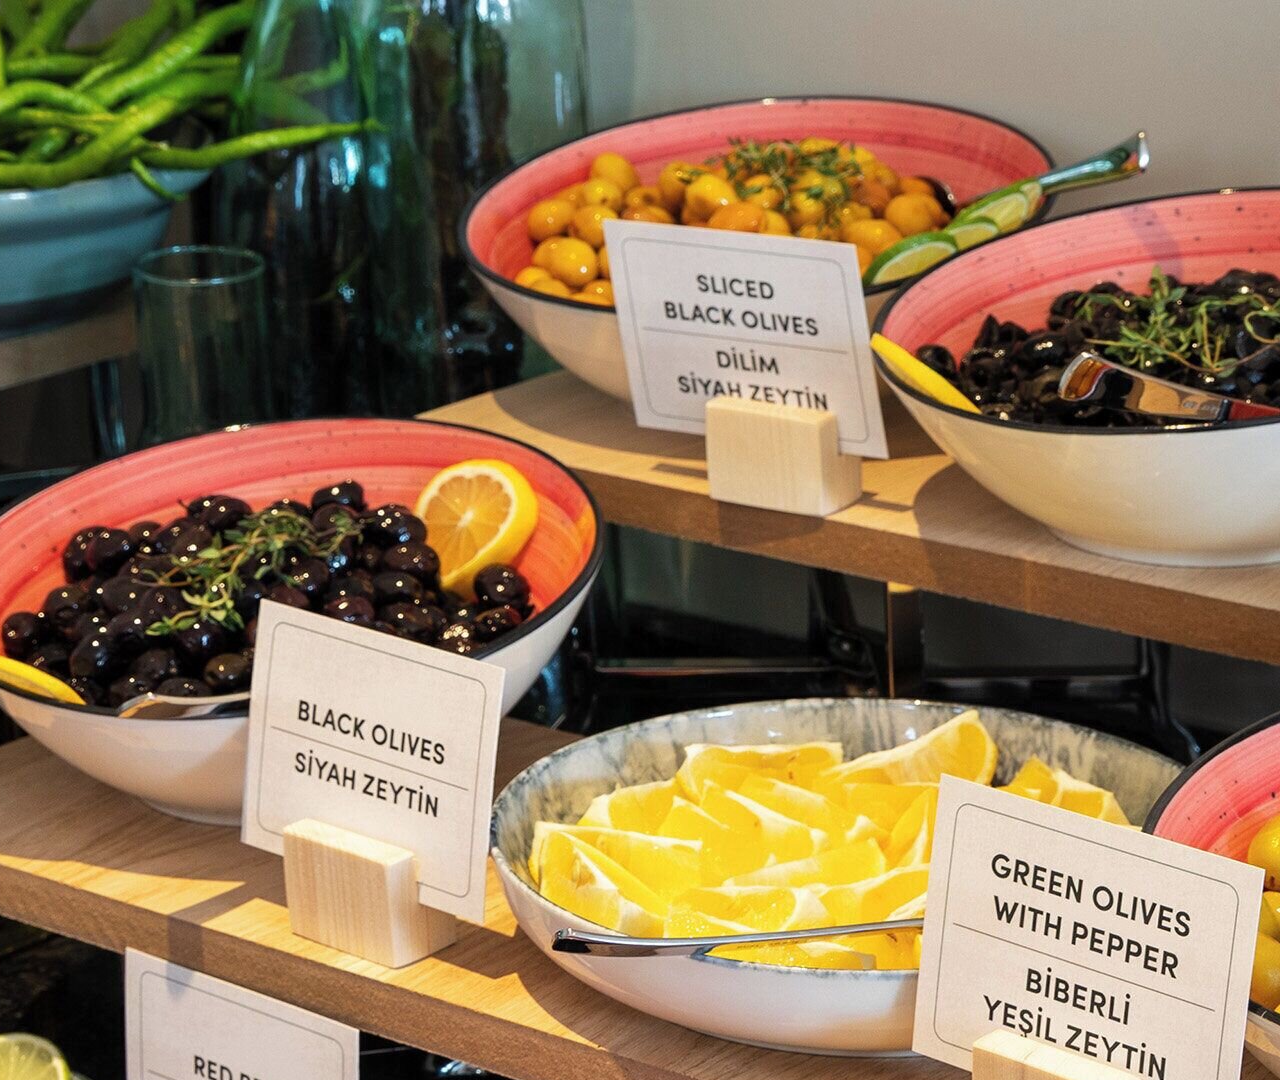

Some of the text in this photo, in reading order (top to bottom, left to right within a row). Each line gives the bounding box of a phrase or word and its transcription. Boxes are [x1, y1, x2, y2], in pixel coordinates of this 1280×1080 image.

[697, 274, 774, 299] SLICED
[664, 301, 819, 336] BLACK OLIVES
[716, 347, 780, 375] DİLİM
[677, 371, 829, 411] SİYAH ZEYTİN
[297, 699, 445, 766] BLACK OLIVES
[294, 750, 439, 818] SİYAH ZEYTİN
[990, 853, 1192, 938] GREEN OLIVES
[993, 895, 1179, 979] WITH PEPPER
[983, 994, 1058, 1044] YEŞİL
[1025, 966, 1132, 1026] BİBERLİ
